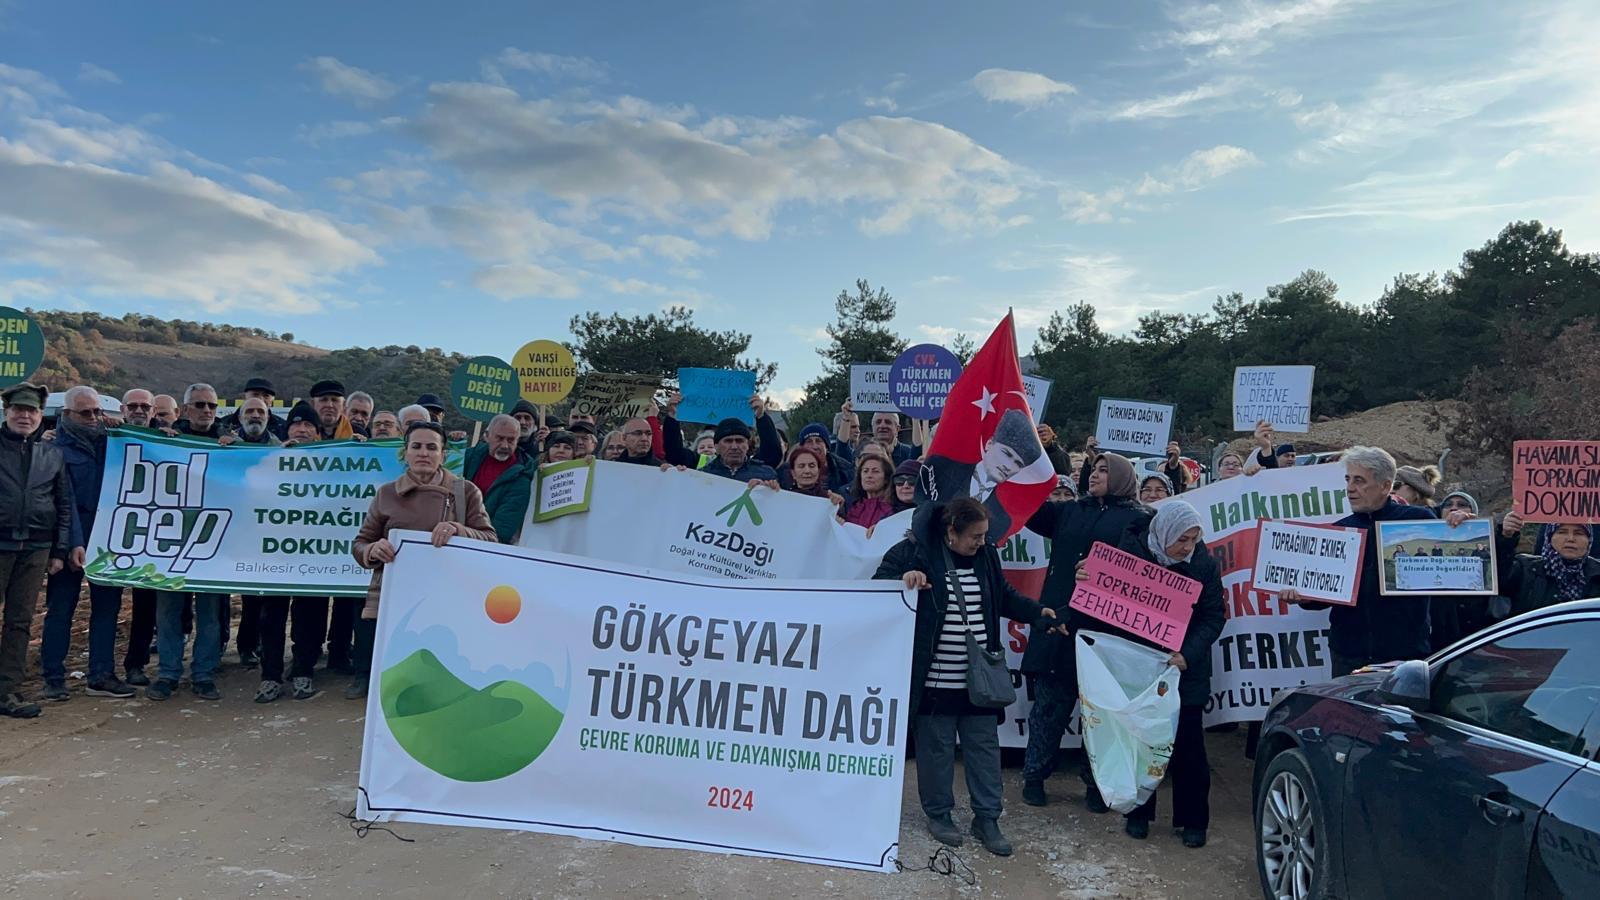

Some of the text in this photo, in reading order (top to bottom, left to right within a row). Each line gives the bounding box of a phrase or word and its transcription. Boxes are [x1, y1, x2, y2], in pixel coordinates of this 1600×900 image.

[529, 352, 558, 365] VAHŞİ
[914, 354, 939, 367] CVK,
[467, 363, 512, 382] MADEN
[901, 366, 952, 381] TÜRKMEN
[1239, 369, 1277, 387] DİRENE
[467, 379, 503, 398] DEĞİL
[524, 382, 562, 394] HAYIR!
[1248, 387, 1289, 403] DİRENE
[459, 395, 505, 415] TARIM!
[899, 395, 925, 408] ELİNİ
[1107, 404, 1164, 424] TÜRKMEN DAĞI'NA
[1108, 429, 1130, 442] VURMA
[278, 456, 383, 472] HAVAMA
[1517, 445, 1581, 466] HAVAMA
[277, 483, 377, 499] SUYUMA
[254, 506, 368, 527] TOPRAĞI
[262, 537, 354, 555] DOKUN
[685, 521, 775, 568] KazDağı
[1271, 530, 1347, 563] TOPRAĞIMIZI EKMEK,
[669, 544, 695, 557] Doğal
[697, 551, 708, 560] ve
[709, 552, 743, 571] Kültürel
[687, 558, 723, 575] Koruma
[235, 561, 294, 574] Balıkesir
[298, 563, 338, 577] Çevre
[1264, 560, 1300, 587] ÜRETMEK
[1096, 571, 1172, 613] TOPRAĞIMI
[1072, 588, 1178, 643] ZEHİRLEME
[591, 602, 822, 671] GÖKÇEYAZI
[587, 662, 898, 747] TÜRKMEN DAĞI
[579, 728, 894, 779] ÇEVRE KORUMA VE DAYANIŞMA DERNEĞİ
[707, 785, 755, 812] 2024
